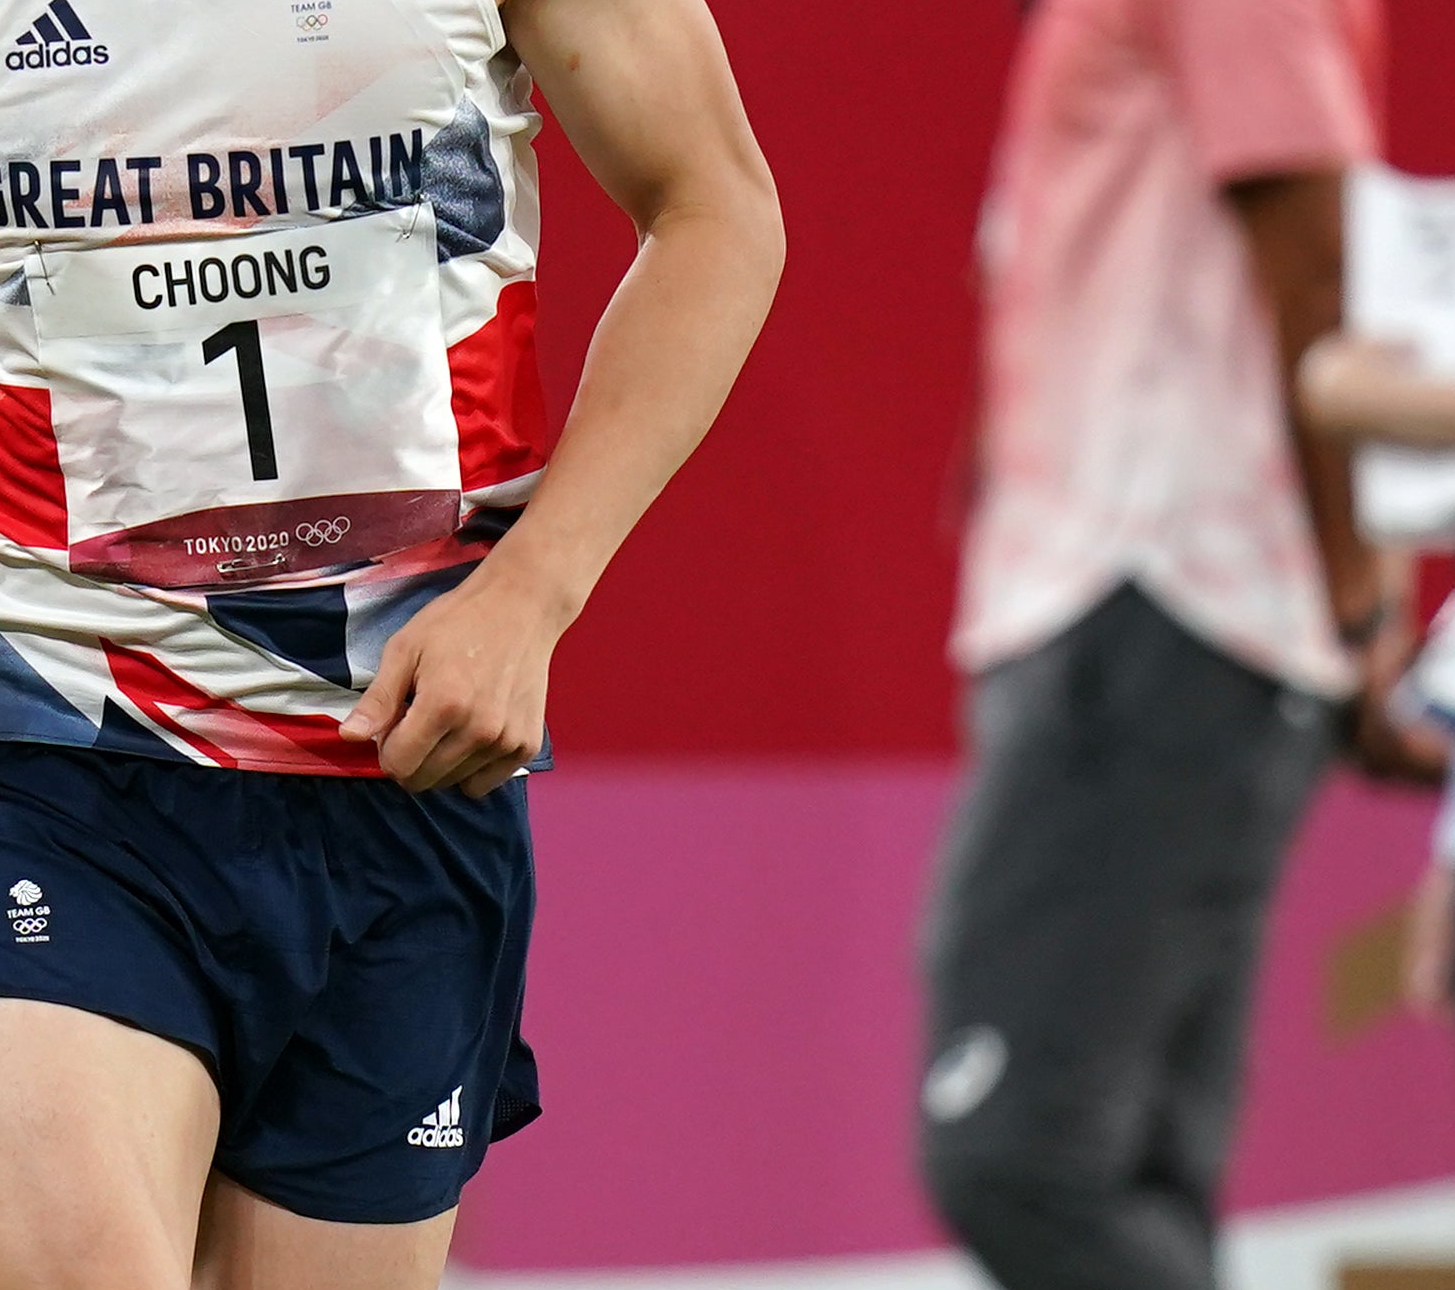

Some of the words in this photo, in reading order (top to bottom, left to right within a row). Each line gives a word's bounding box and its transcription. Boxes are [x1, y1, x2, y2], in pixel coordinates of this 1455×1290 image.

[291, 2, 316, 13] TEAM
[318, 1, 332, 10] GB
[5, 40, 109, 71] adidas
[186, 128, 423, 221] BRITAIN
[132, 245, 331, 310] CHOONG
[202, 319, 278, 481] 1
[183, 536, 242, 555] TOKYO
[245, 531, 289, 552] 2020
[7, 907, 34, 919] TEAM
[35, 905, 51, 915] GB
[407, 1124, 464, 1148] adidas
